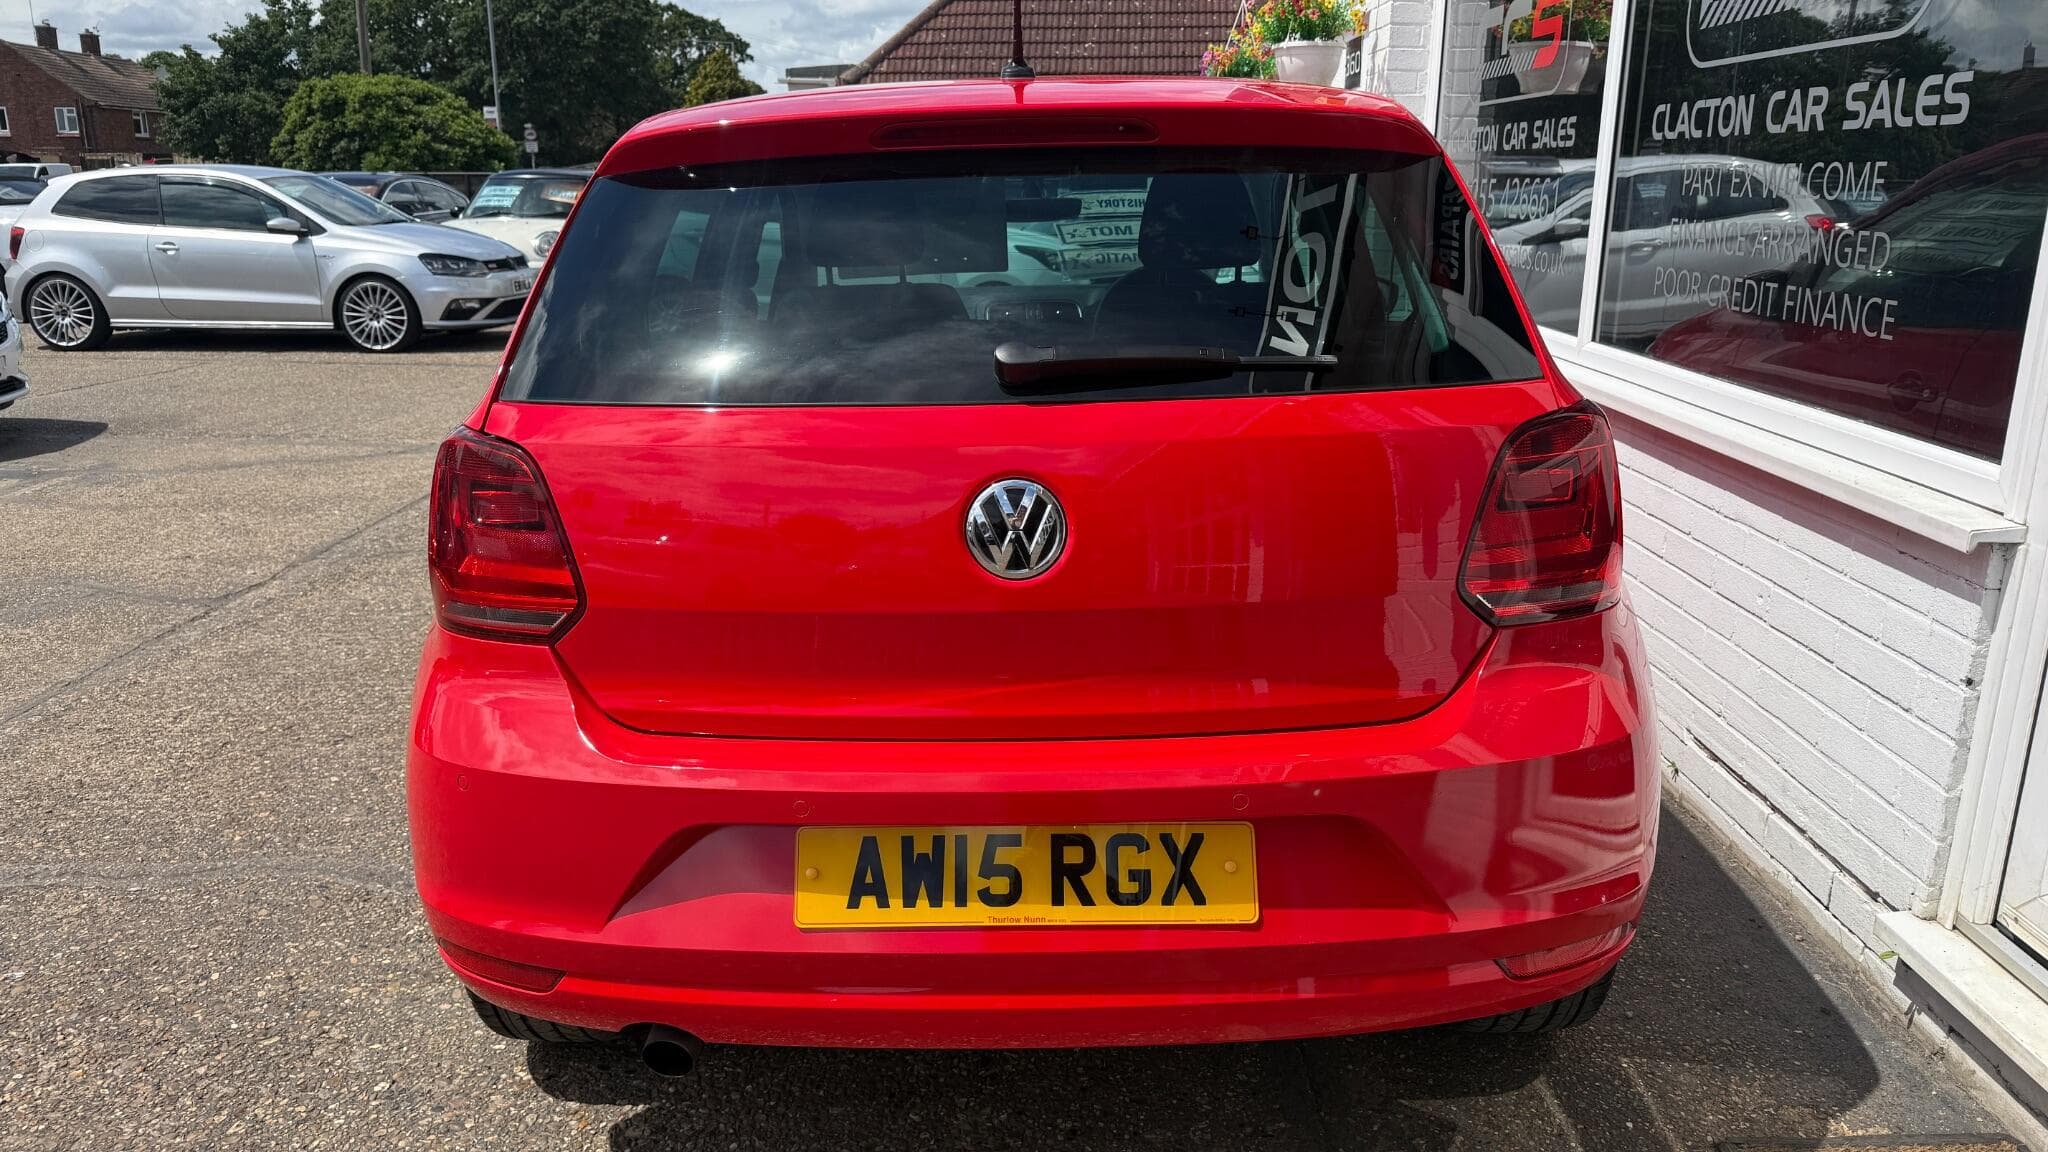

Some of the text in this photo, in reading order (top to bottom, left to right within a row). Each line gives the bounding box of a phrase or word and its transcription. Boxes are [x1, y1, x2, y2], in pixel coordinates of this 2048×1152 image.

[1651, 70, 1975, 141] CLACTON CAR SALES
[1502, 121, 1528, 150] CAR
[1532, 116, 1577, 149] SALES
[1499, 176, 1561, 222] 426661
[1681, 163, 1723, 197] PART
[1730, 164, 1753, 198] EX
[1761, 161, 1888, 202] WELCOME
[1668, 218, 1745, 256] FINANCE
[1751, 224, 1891, 272] ARRANGED
[1653, 266, 1899, 341] POOR CREDIT FINANCE
[846, 831, 1207, 910] AW15 RGX
[988, 915, 1021, 924] Thurlow
[1024, 915, 1046, 924] Nunn
